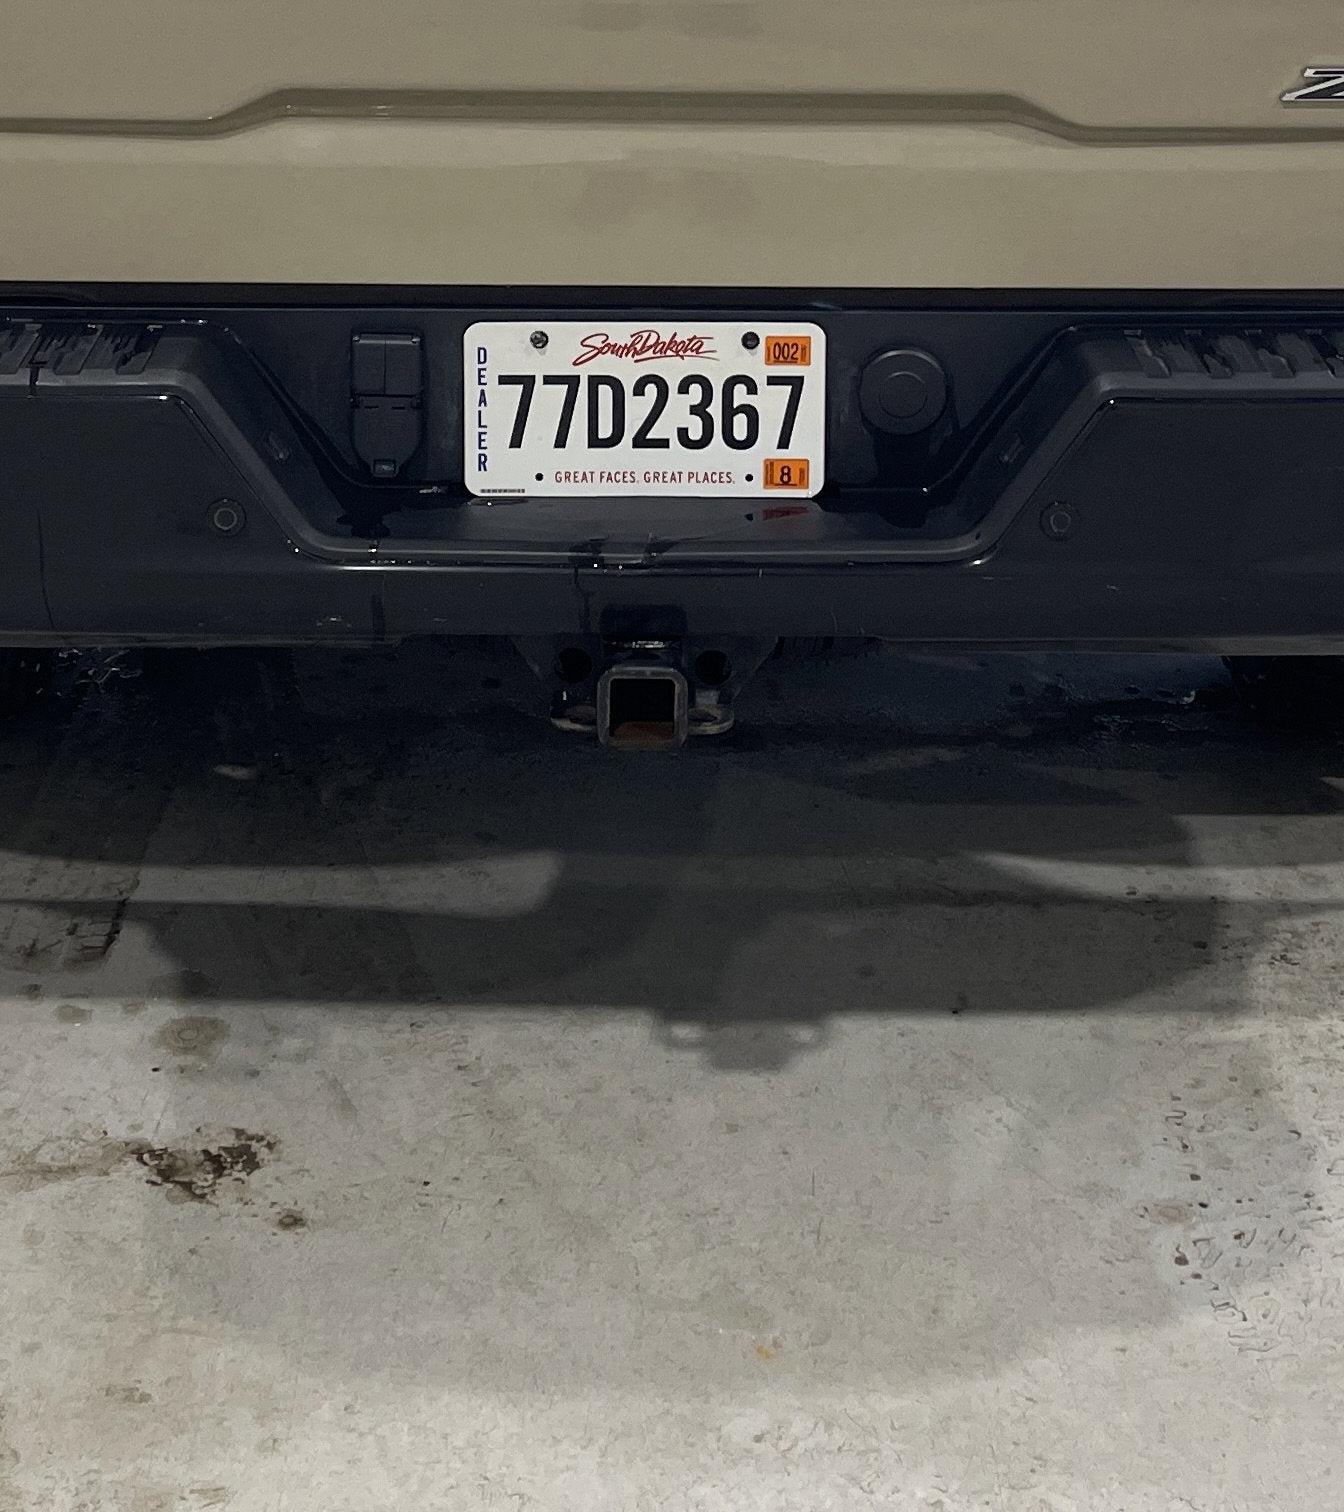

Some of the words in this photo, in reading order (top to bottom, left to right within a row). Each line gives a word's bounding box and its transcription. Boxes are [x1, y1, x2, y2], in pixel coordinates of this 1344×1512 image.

[772, 342, 798, 361] 002
[477, 347, 488, 472] DEALER
[498, 374, 805, 450] 77D2367
[555, 471, 594, 483] GREAT
[599, 471, 640, 484] FACES.
[644, 471, 683, 484] GREAT
[687, 471, 735, 484] PLACES.
[780, 466, 791, 485] 8
